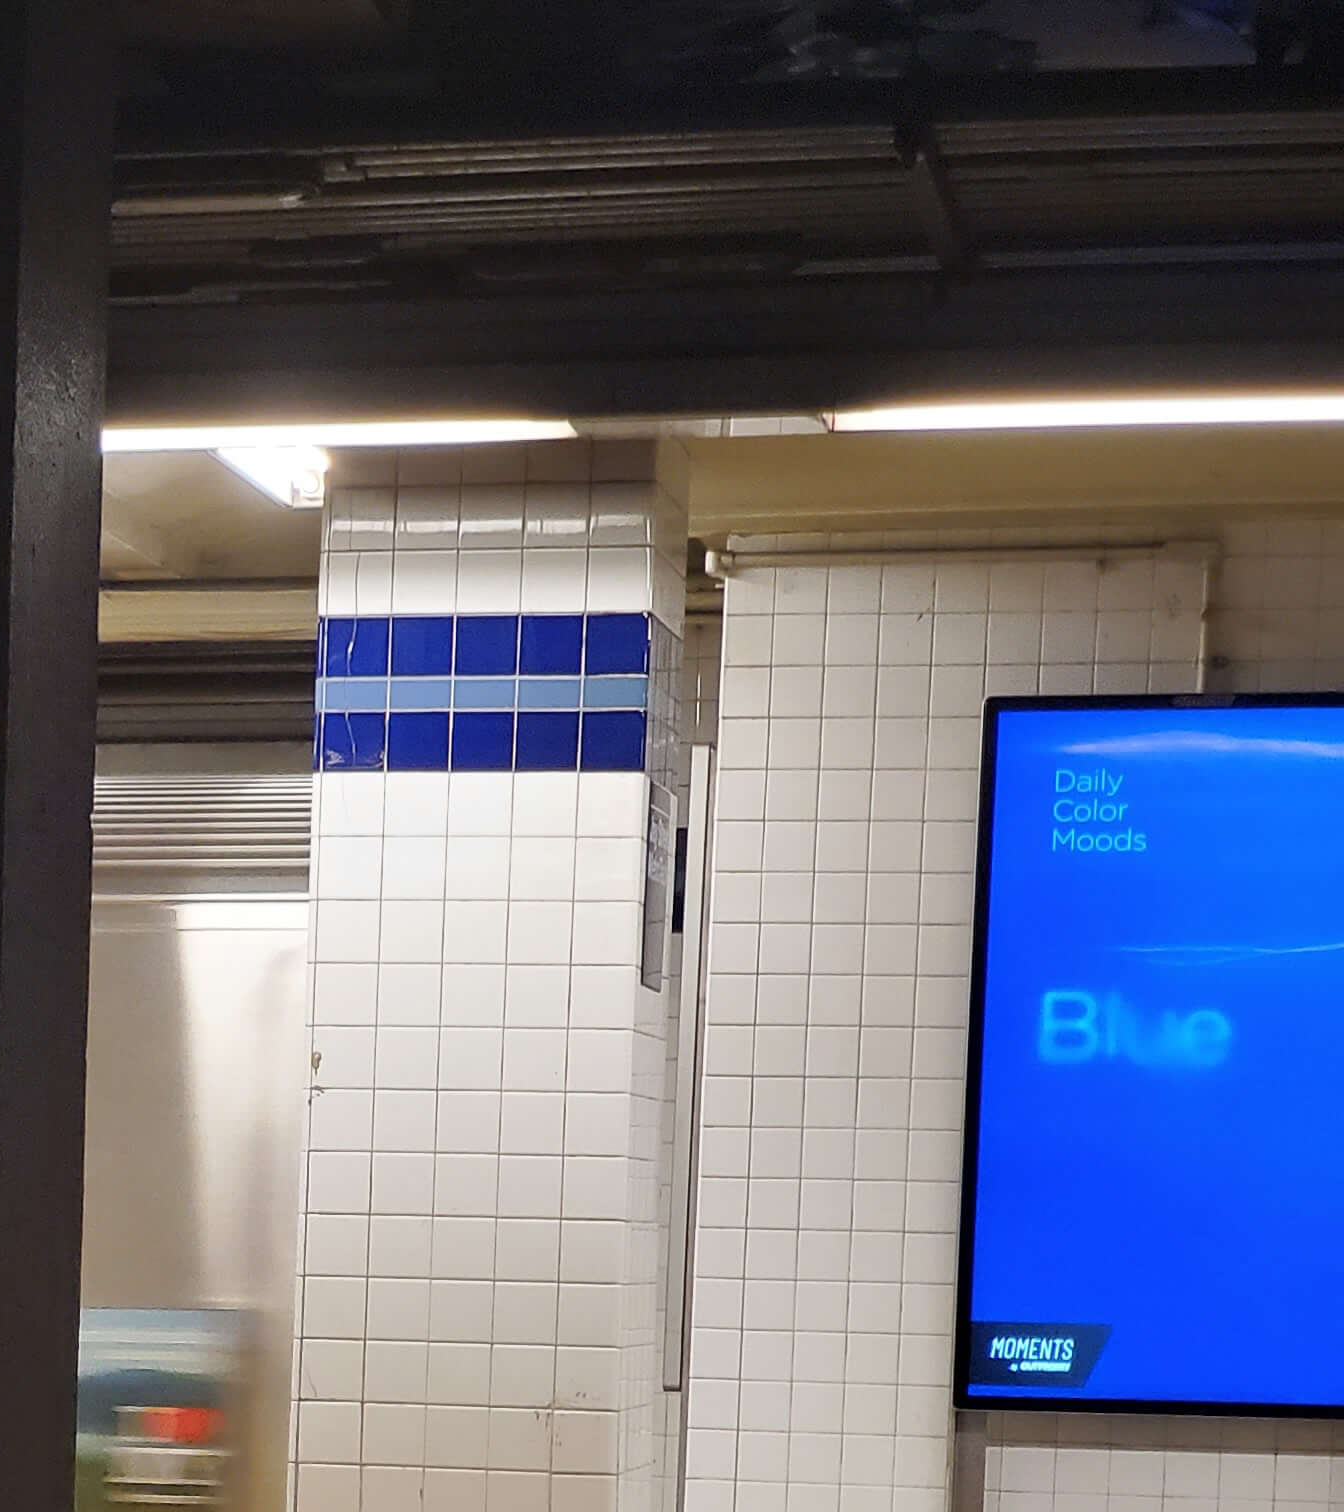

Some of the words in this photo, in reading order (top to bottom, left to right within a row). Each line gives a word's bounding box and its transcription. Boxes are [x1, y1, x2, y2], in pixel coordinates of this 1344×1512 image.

[1055, 768, 1123, 796] Daily
[1054, 799, 1128, 822] Color
[1052, 827, 1147, 852] Moods
[1039, 990, 1233, 1067] Blue
[990, 1336, 1074, 1361] MOMENTS
